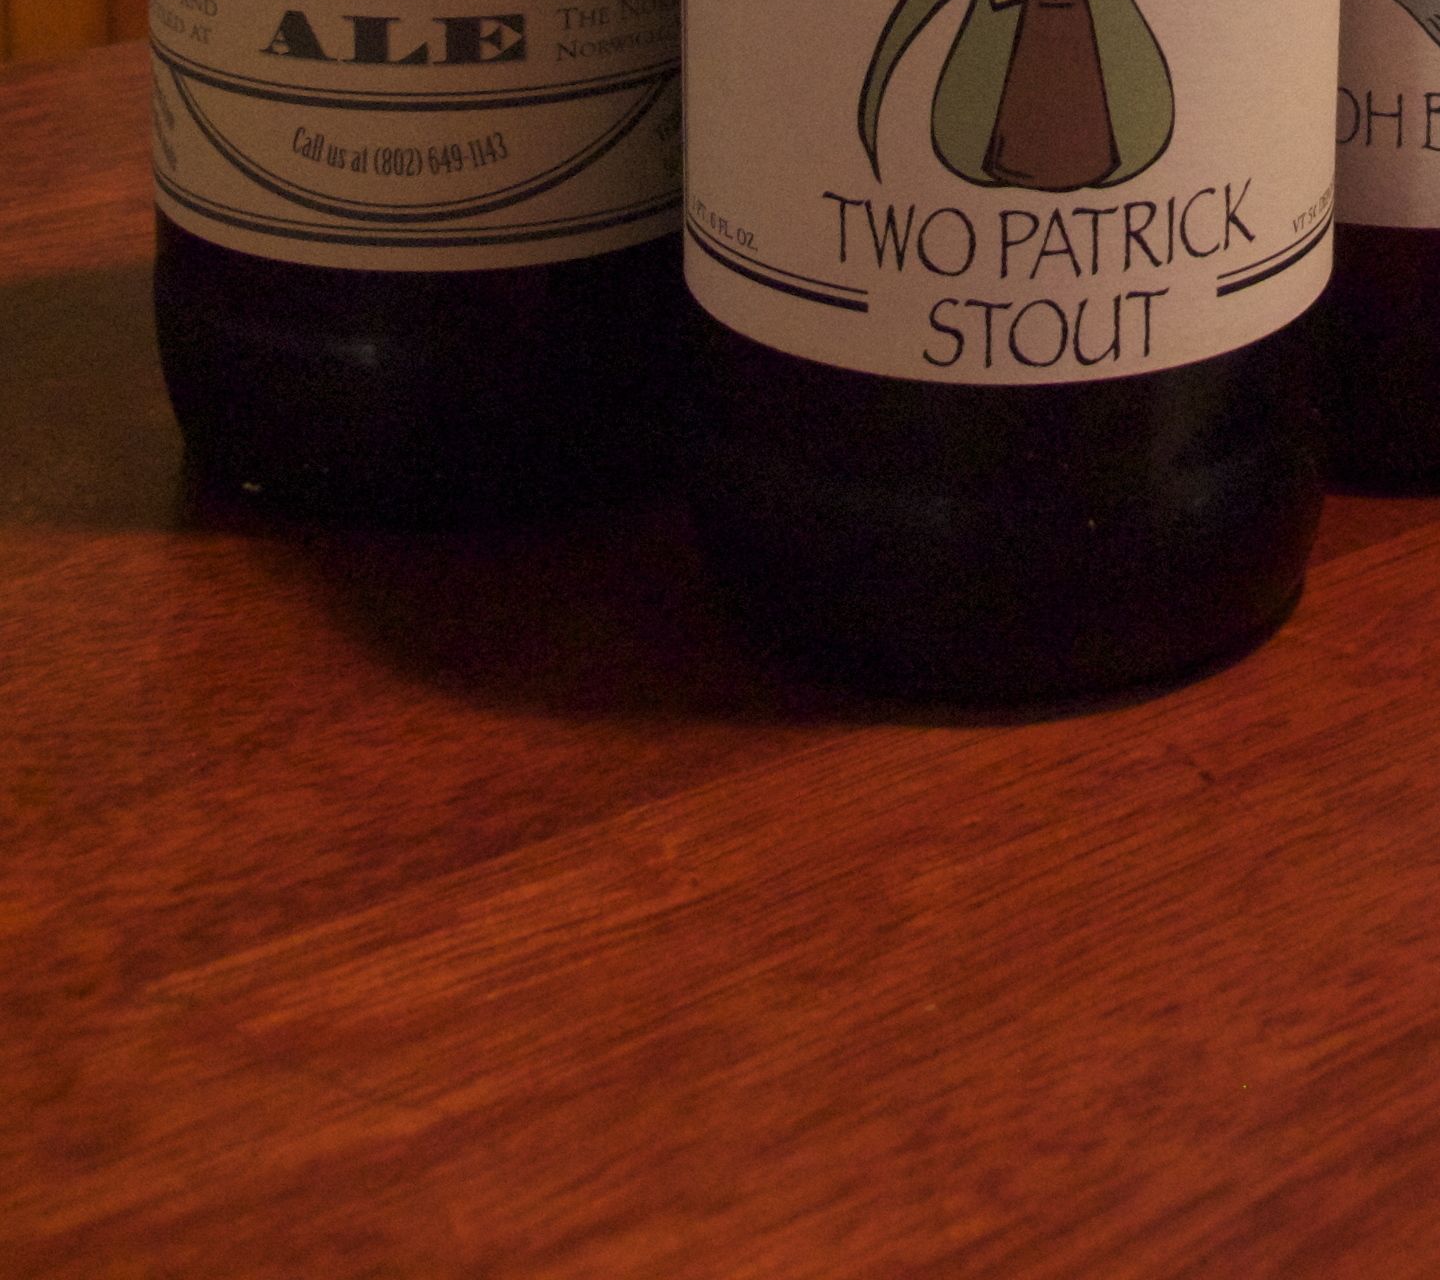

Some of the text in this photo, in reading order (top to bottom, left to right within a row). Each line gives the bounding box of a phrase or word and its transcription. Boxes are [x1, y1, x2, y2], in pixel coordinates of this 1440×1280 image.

[260, 10, 528, 66] ALE
[292, 126, 509, 177] Call us at (802) 649-1143
[822, 177, 1257, 280] TWO PATRICK
[922, 287, 1171, 369] STOUT
